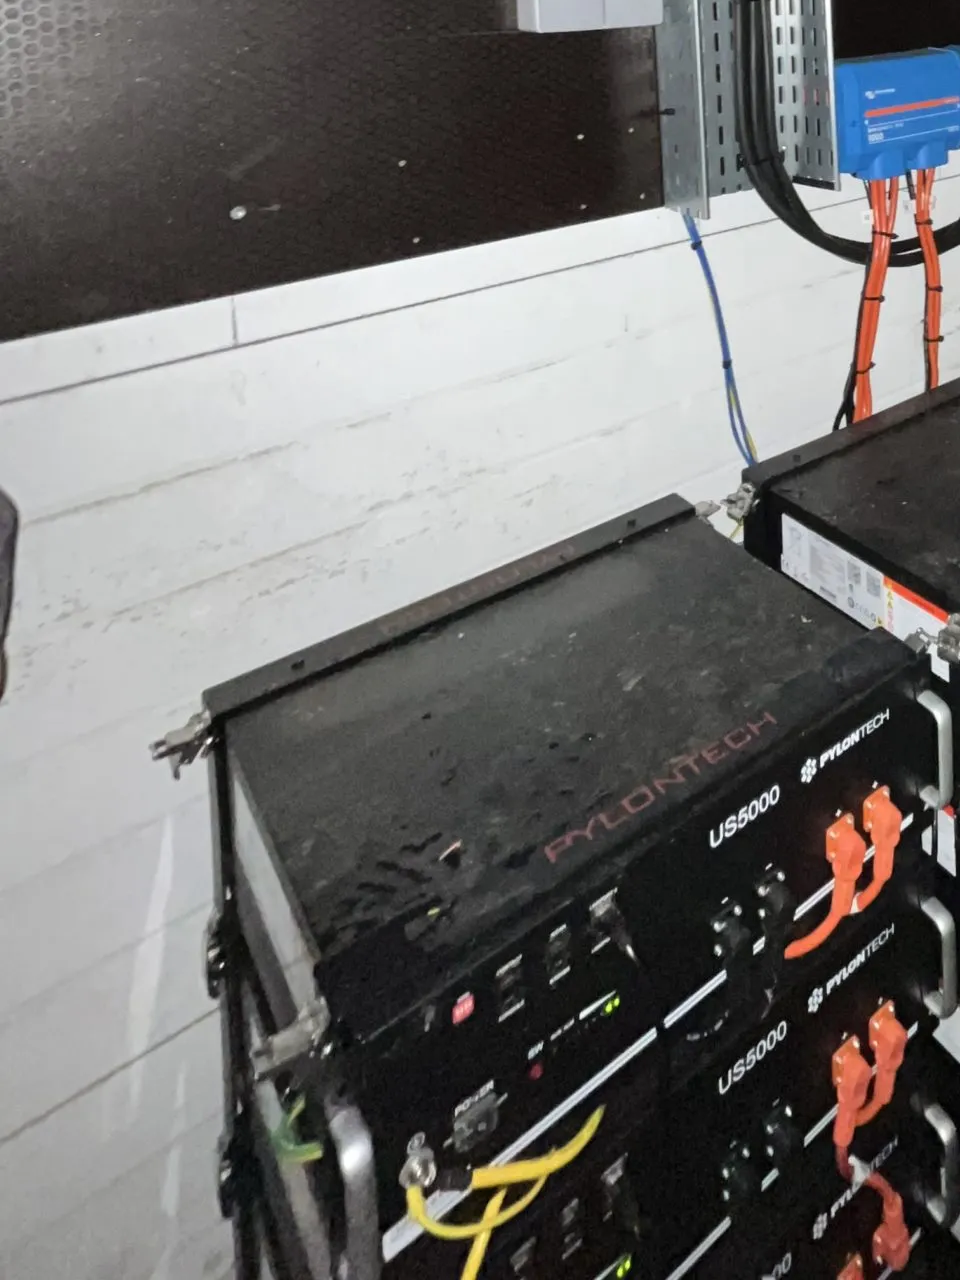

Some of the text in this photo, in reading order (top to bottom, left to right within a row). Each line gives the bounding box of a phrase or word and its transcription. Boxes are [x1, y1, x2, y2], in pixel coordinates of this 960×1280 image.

[819, 709, 890, 769] PYLONTECH
[544, 712, 777, 864] PYLONTECH
[709, 784, 781, 849] US5000
[826, 923, 895, 996] PYLONTECH
[718, 1020, 788, 1096] US5000
